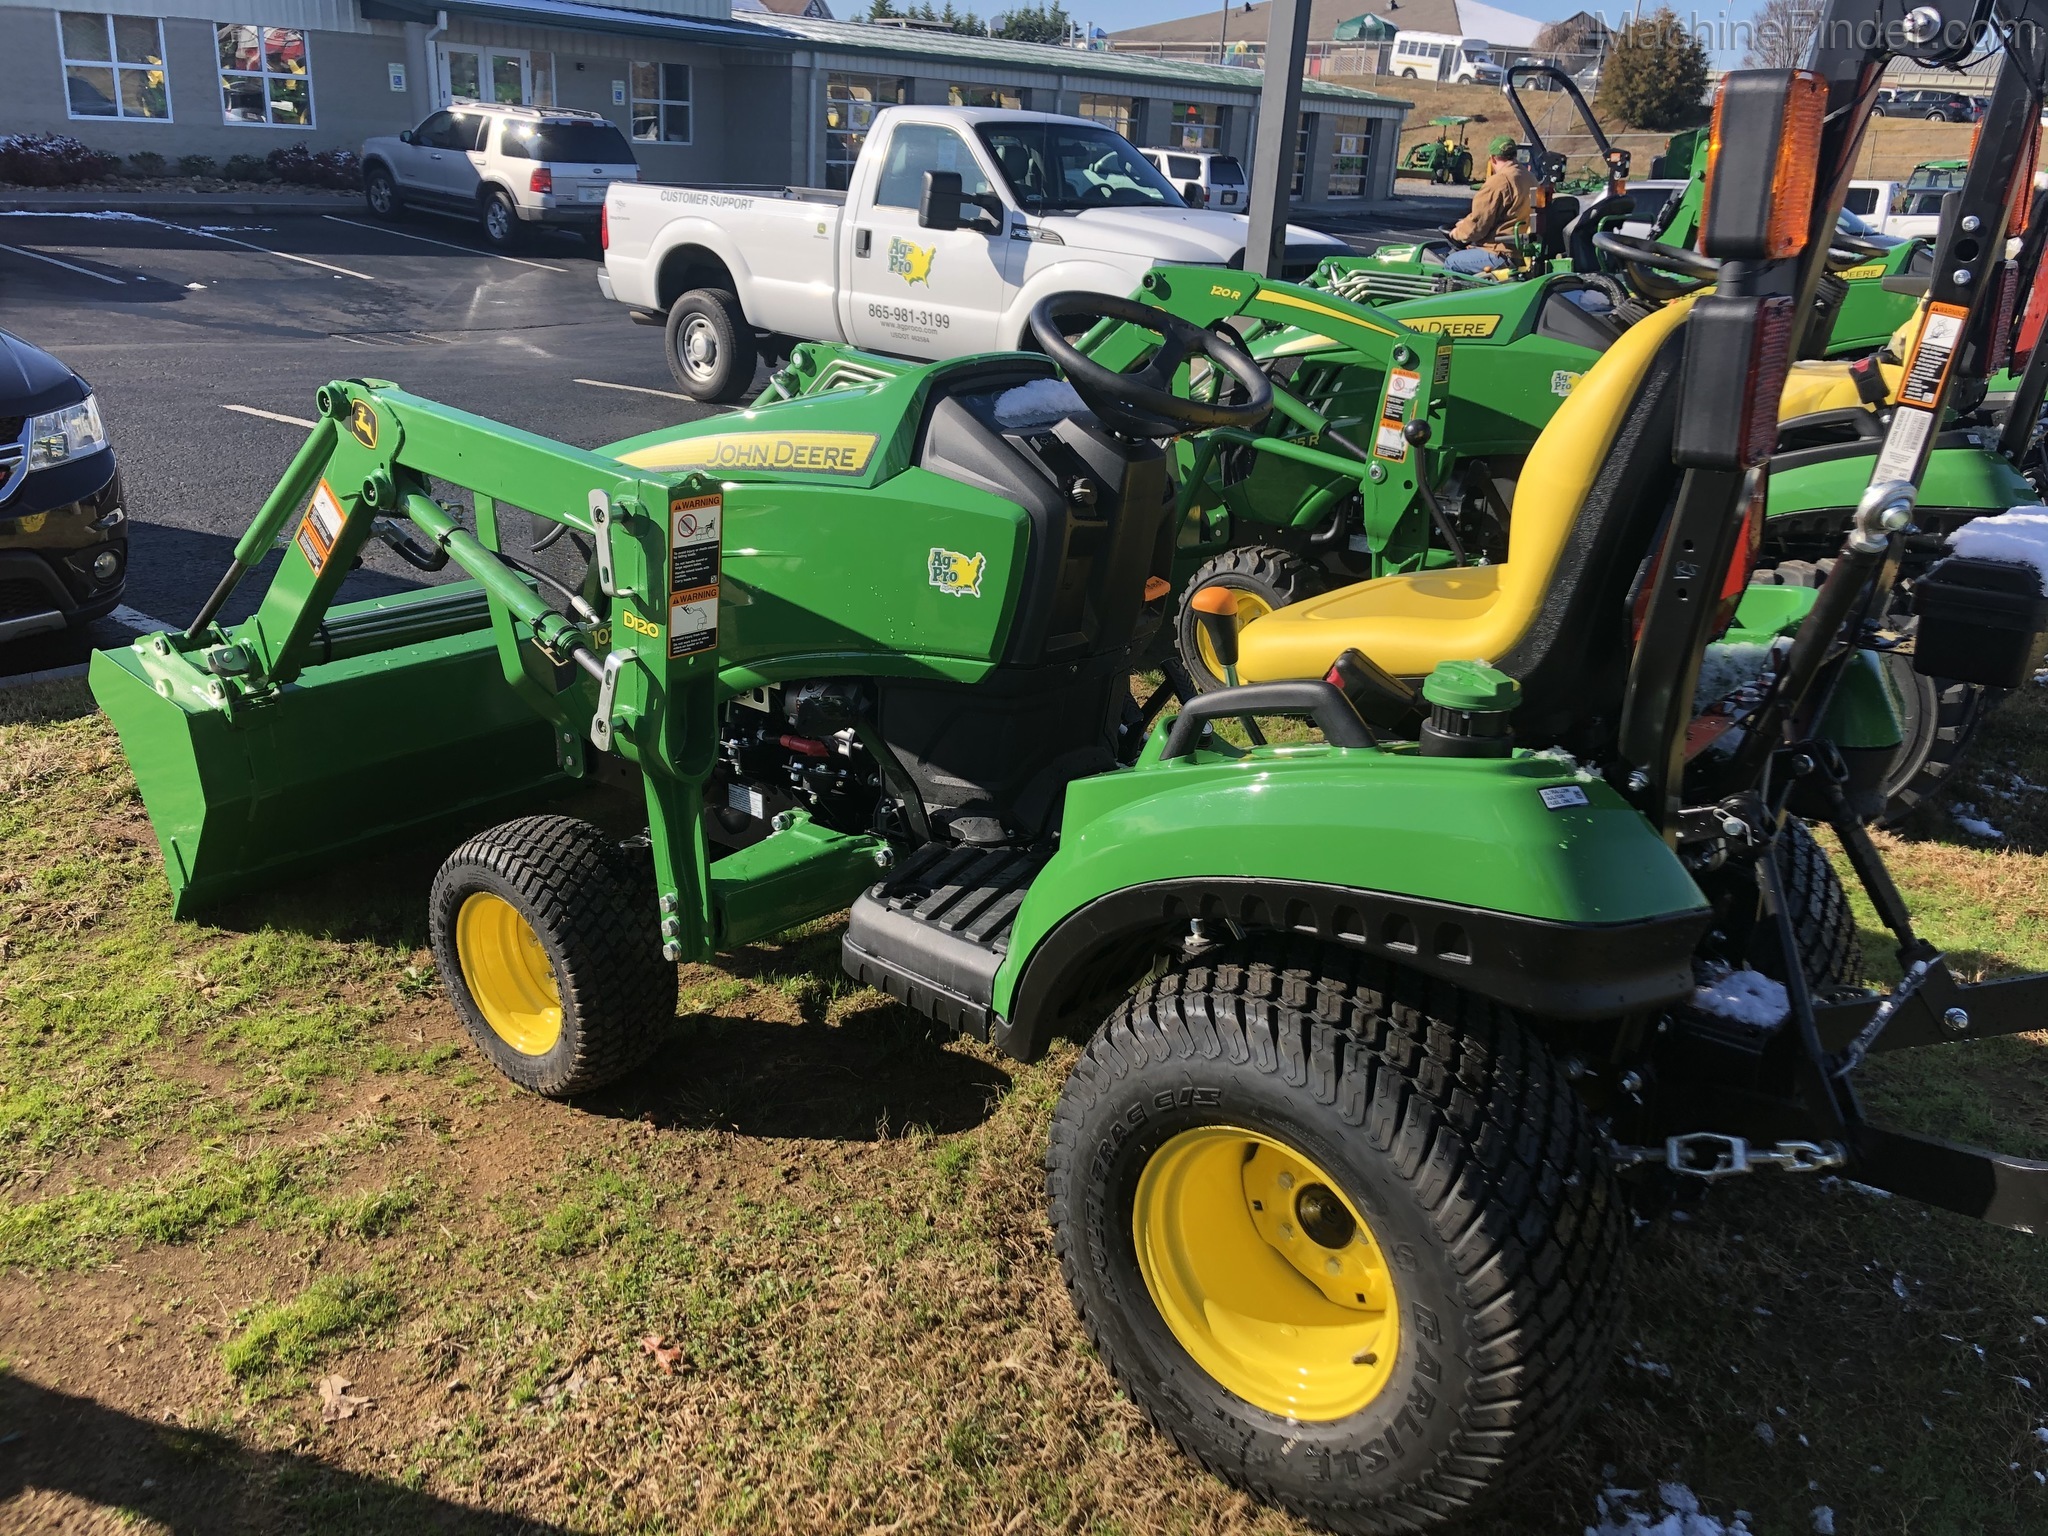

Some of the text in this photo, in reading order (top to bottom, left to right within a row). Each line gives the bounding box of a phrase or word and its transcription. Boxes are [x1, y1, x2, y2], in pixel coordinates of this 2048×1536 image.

[660, 190, 755, 211] CUSTOMER SUPPORT
[889, 238, 913, 259] Ag-
[888, 256, 913, 273] Pro
[1211, 285, 1231, 298] 120
[868, 303, 950, 329] 865-981-3199
[880, 320, 938, 335] www.agproco.com
[1554, 381, 1572, 391] Pro
[706, 441, 857, 468] JOHN DEERE
[681, 496, 720, 509] WARNING
[931, 551, 957, 570] Ag-
[932, 567, 958, 583] Pro
[680, 588, 717, 603] WARNING
[623, 609, 660, 640] D120
[1089, 1101, 1150, 1186] TRAC
[1303, 1300, 1442, 1483] CARLISLE
